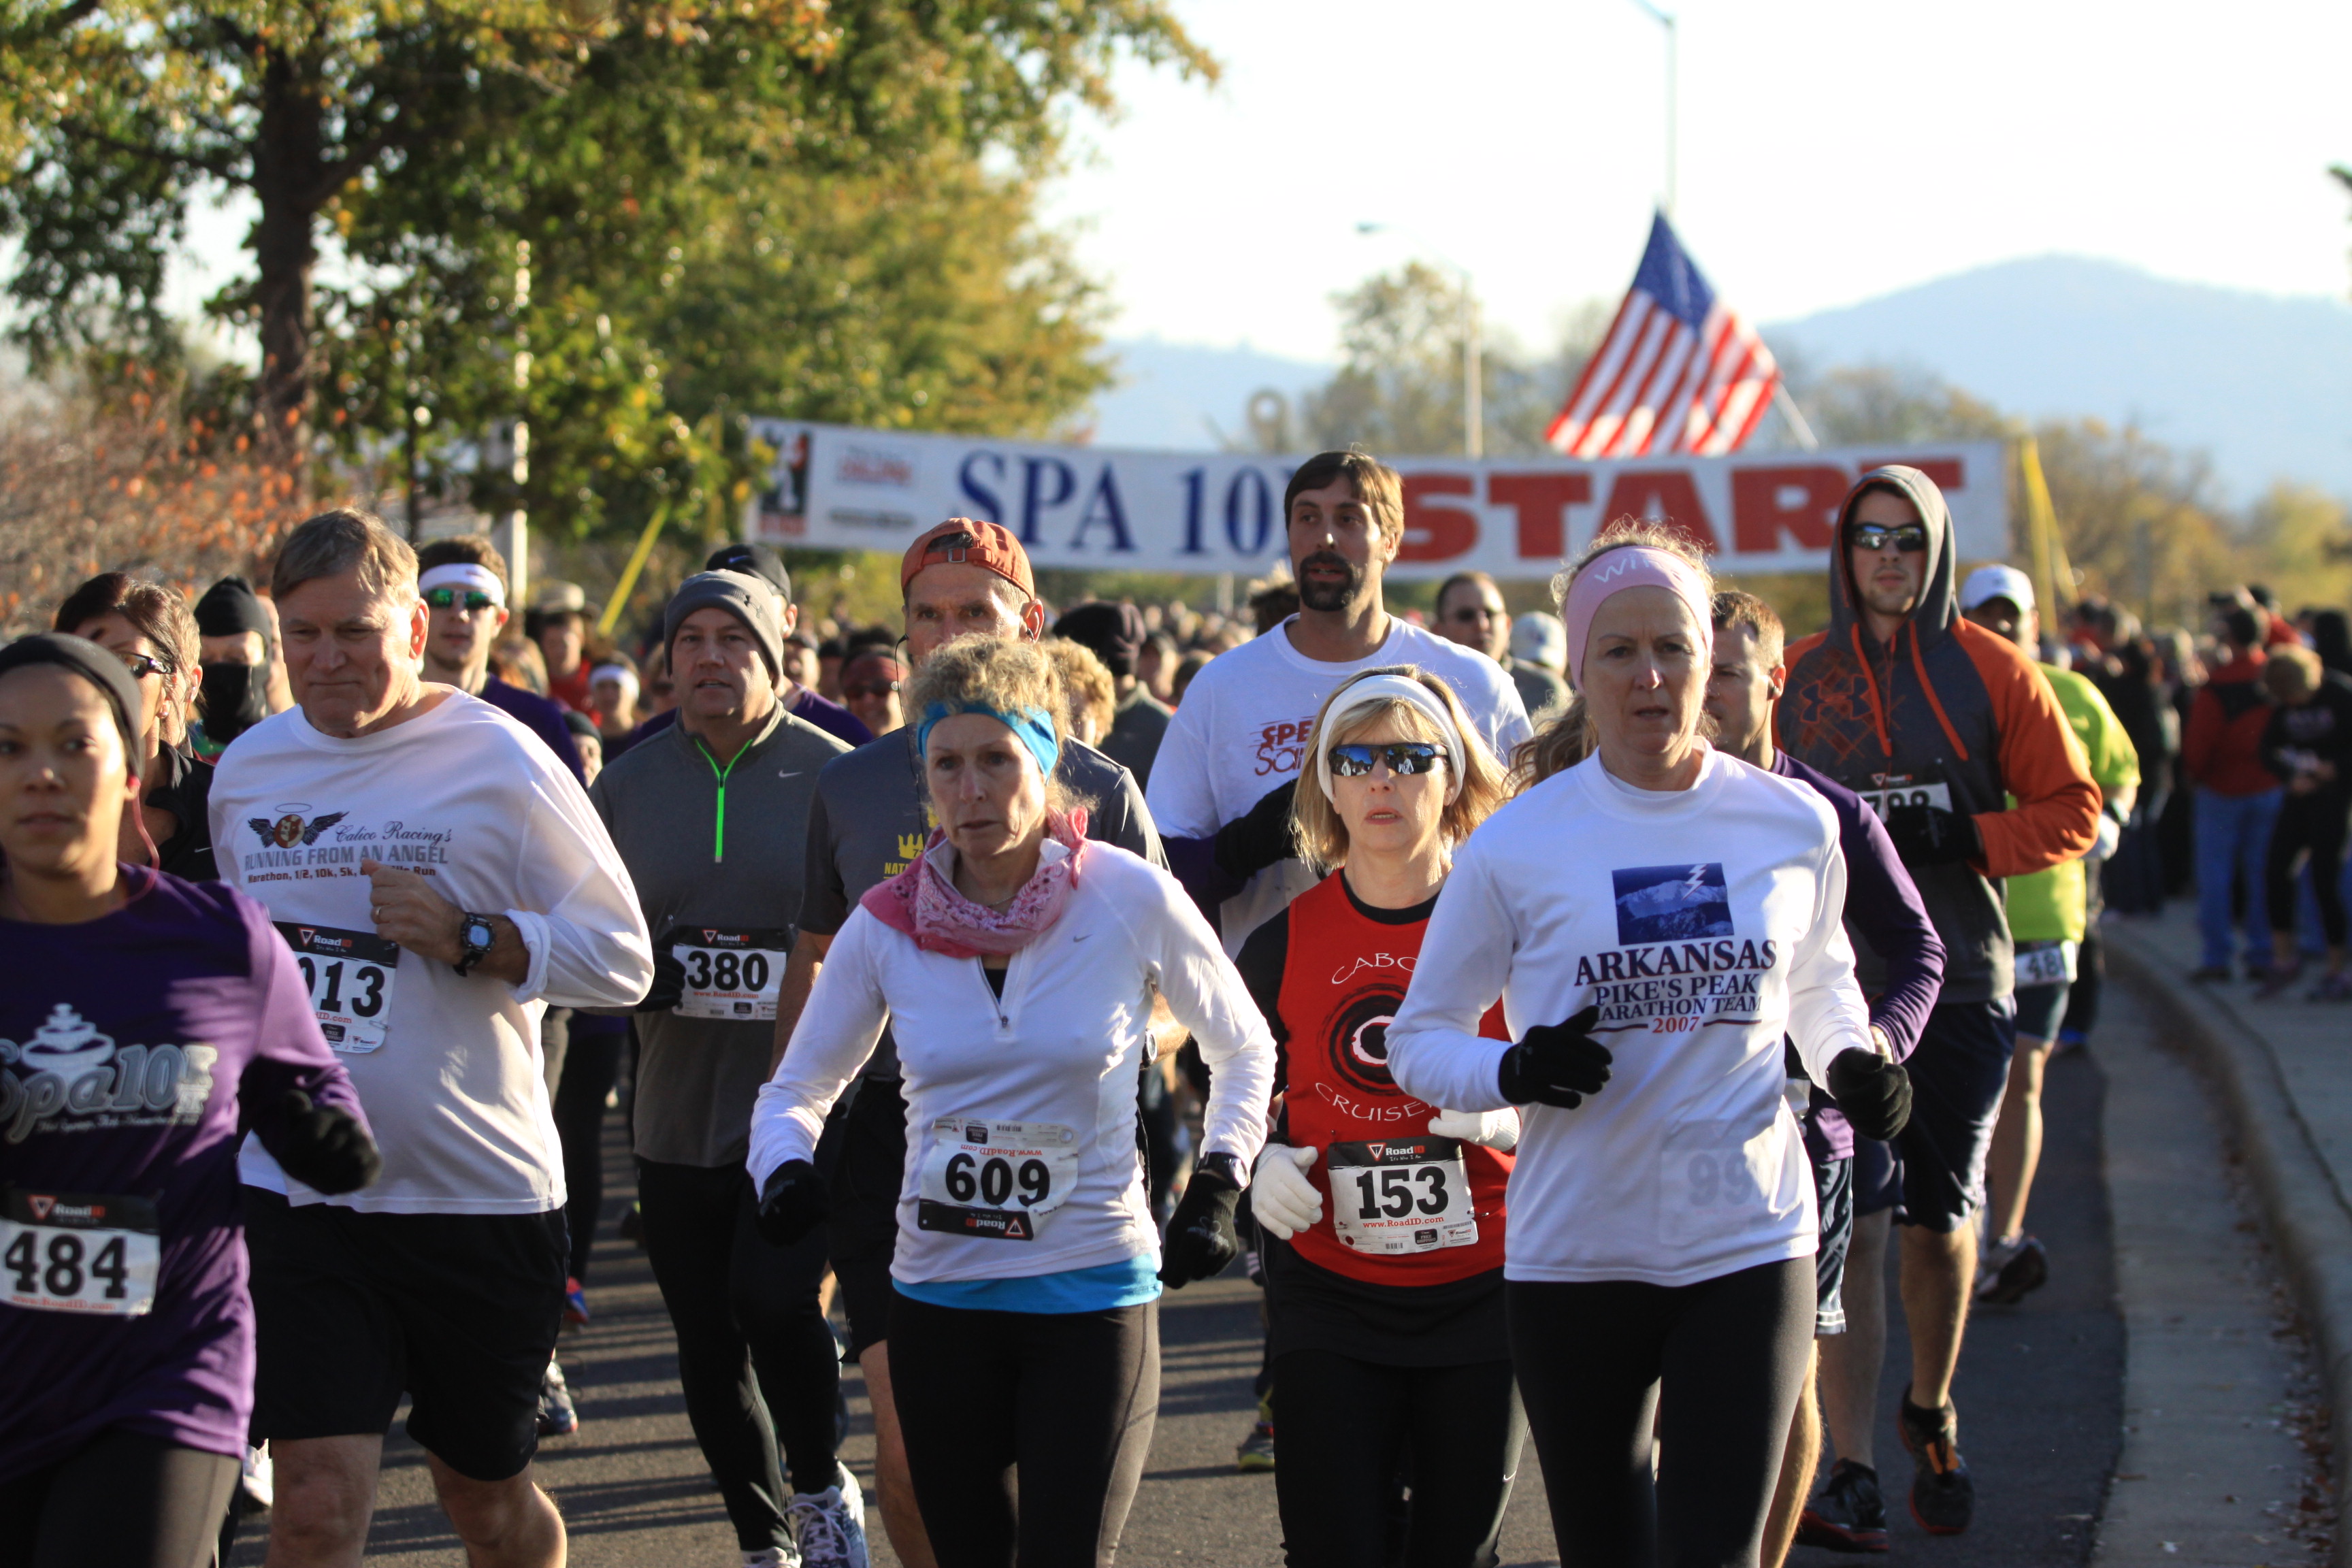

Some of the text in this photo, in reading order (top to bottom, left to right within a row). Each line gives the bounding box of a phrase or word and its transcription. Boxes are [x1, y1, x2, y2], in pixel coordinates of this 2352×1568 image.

[958, 449, 1139, 553] SPA
[1177, 465, 1292, 557] 10
[336, 821, 453, 848] Calico Racing's
[244, 845, 448, 872] RUNNING FROM AN ANGEL
[248, 871, 293, 884] Marathon,
[295, 869, 313, 880] 1/2,
[315, 868, 338, 879] 10k,
[340, 866, 357, 877] 5k,
[413, 866, 436, 876] Run
[687, 950, 769, 992] 380
[1573, 938, 1777, 986] ARKANSAS
[1595, 973, 1760, 1007] PIKE'S PEAK
[1601, 995, 1763, 1021] ARATHON TEAM
[1652, 1015, 1701, 1034] 2007
[1315, 1082, 1433, 1122] CRUISE
[960, 1144, 1043, 1157] www.RoadID.com
[1385, 1145, 1426, 1156] RoadID
[945, 1153, 1051, 1207] 609
[1356, 1166, 1449, 1220] 153
[1362, 1216, 1445, 1228] www.RoadID.com
[5, 1230, 129, 1299] 484
